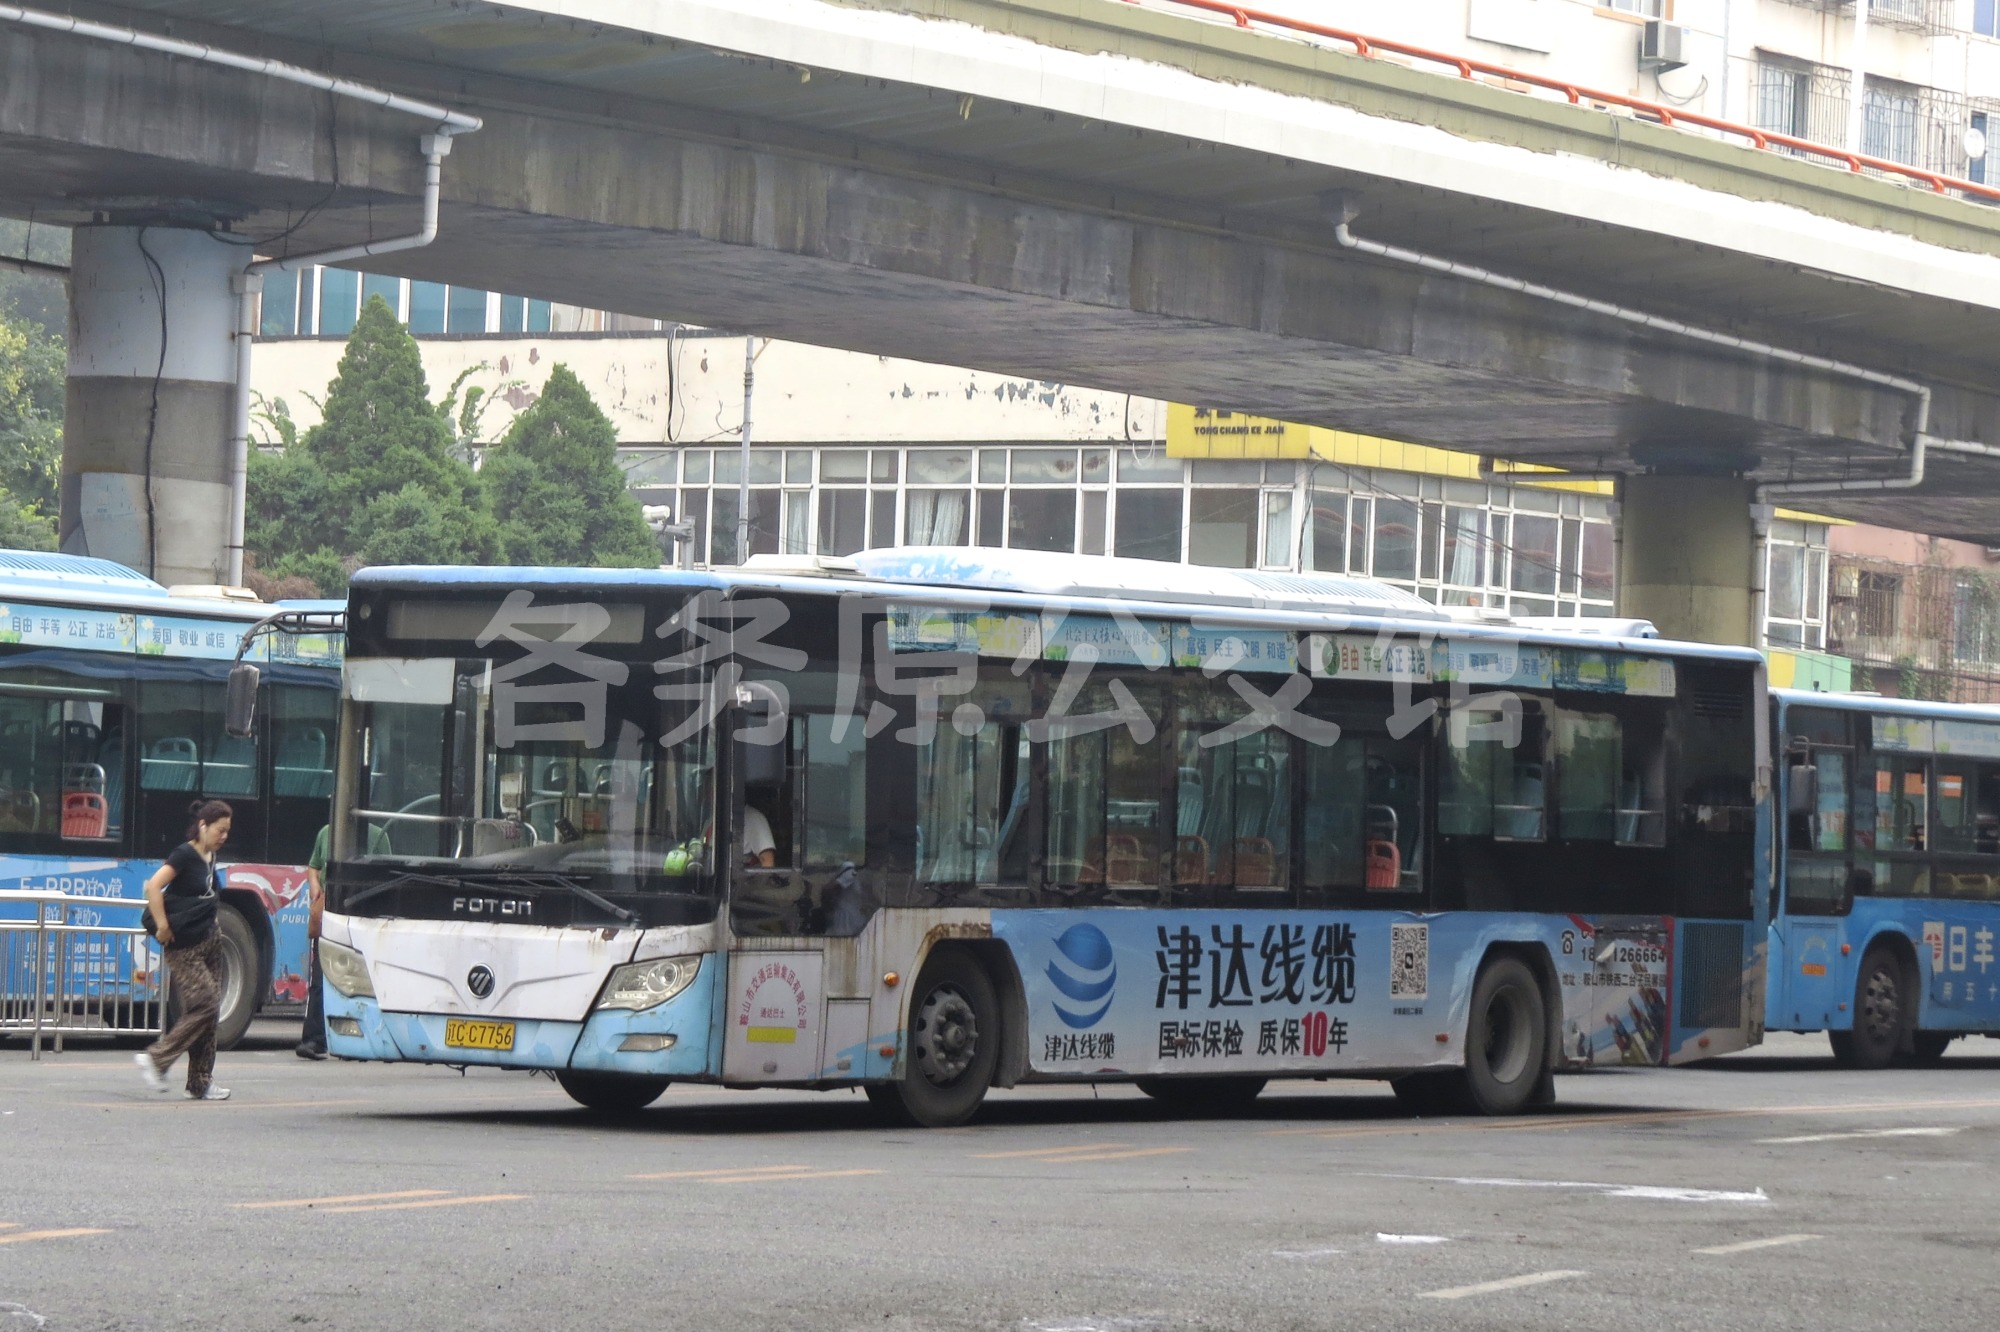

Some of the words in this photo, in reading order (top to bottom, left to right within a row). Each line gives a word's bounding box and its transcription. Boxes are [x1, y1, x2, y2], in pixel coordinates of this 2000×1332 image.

[1251, 426, 1261, 435] KE
[12, 616, 32, 633] 自由
[40, 618, 60, 636] 平等
[68, 620, 88, 638] 公正
[96, 622, 116, 640] 法治
[153, 627, 172, 645] 爱国
[206, 631, 225, 648] 诚信
[1267, 641, 1286, 660] 和谐
[1342, 643, 1359, 671] 自由
[1363, 645, 1382, 673] 平等
[1386, 647, 1403, 673] 公正
[1408, 648, 1426, 675] 法治
[453, 898, 532, 915] FOTON
[1155, 922, 1357, 1010] 津达线缆
[1044, 1032, 1115, 1062] 津达线缆
[1158, 1018, 1244, 1060] 国标保检
[1257, 1010, 1349, 1058] 质保10年
